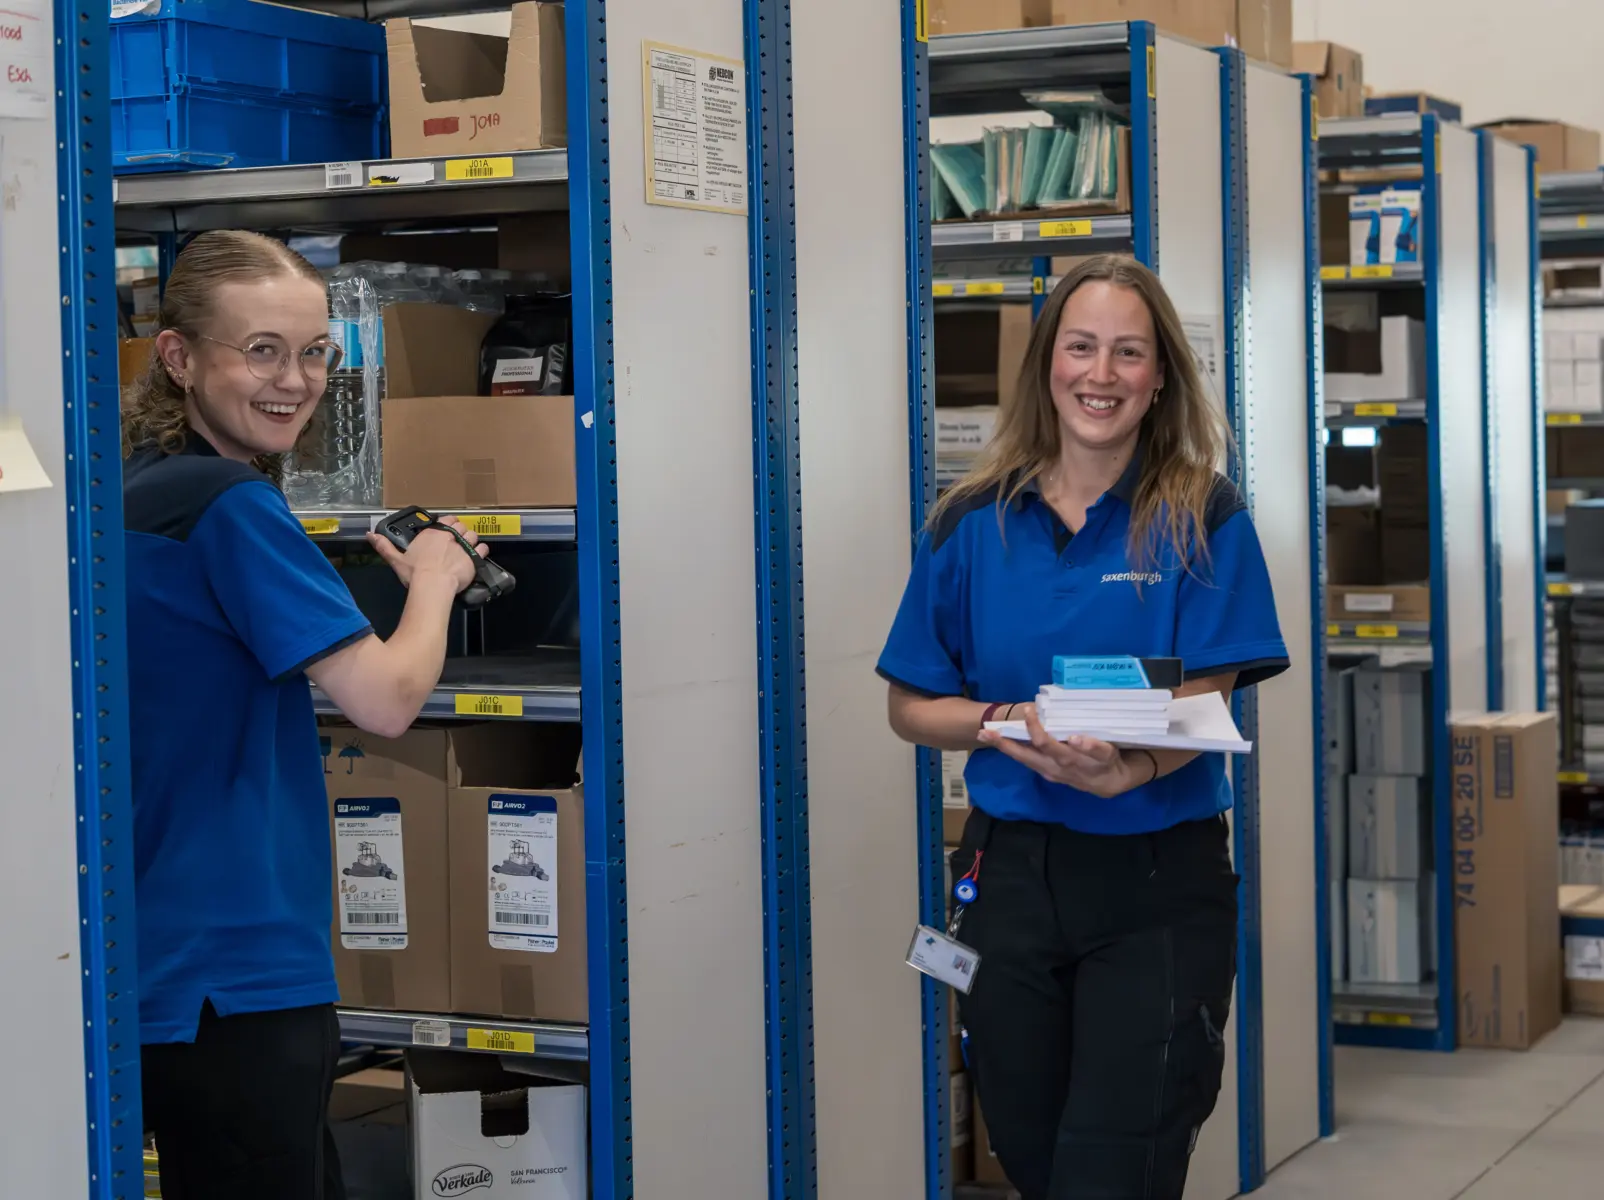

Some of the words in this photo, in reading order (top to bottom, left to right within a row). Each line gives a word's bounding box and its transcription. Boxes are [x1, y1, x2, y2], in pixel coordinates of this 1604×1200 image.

[469, 159, 489, 168] J01A
[477, 516, 497, 525] J01B
[1100, 570, 1162, 585] saxenburgh
[479, 696, 499, 705] J01C
[1454, 735, 1474, 767] SE
[490, 1031, 511, 1041] J01D
[434, 1169, 491, 1193] Verkade
